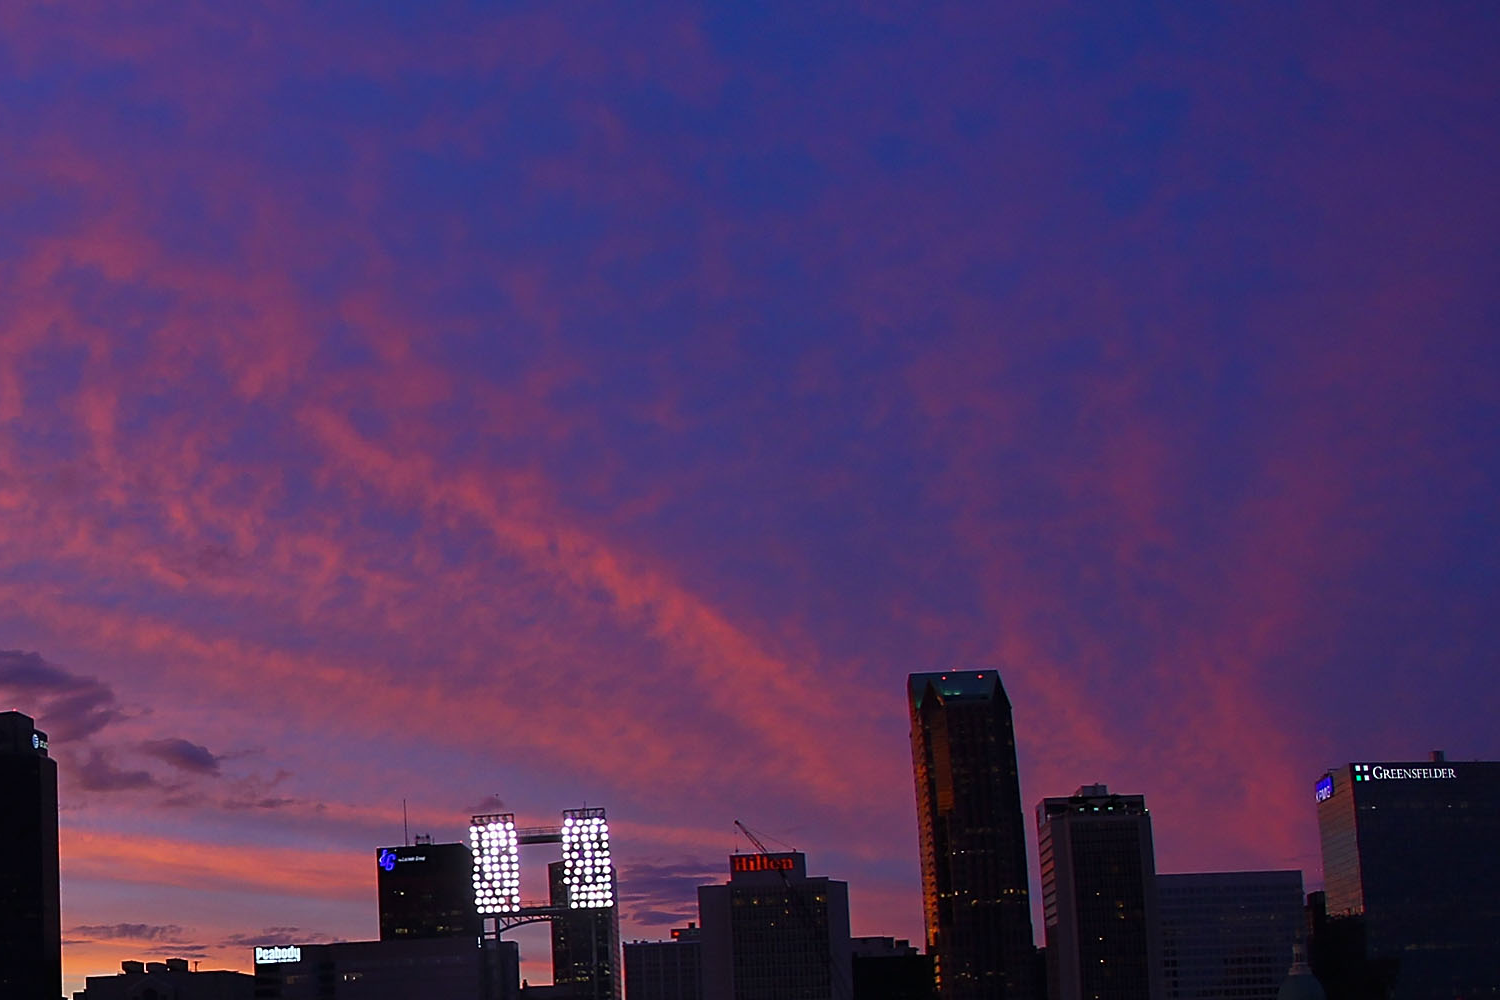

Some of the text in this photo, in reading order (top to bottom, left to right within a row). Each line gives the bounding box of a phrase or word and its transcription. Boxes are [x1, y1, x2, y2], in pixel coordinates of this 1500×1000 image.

[1372, 766, 1457, 780] GREENSFELDER
[734, 854, 794, 872] Hilton
[255, 945, 301, 962] Peabody
